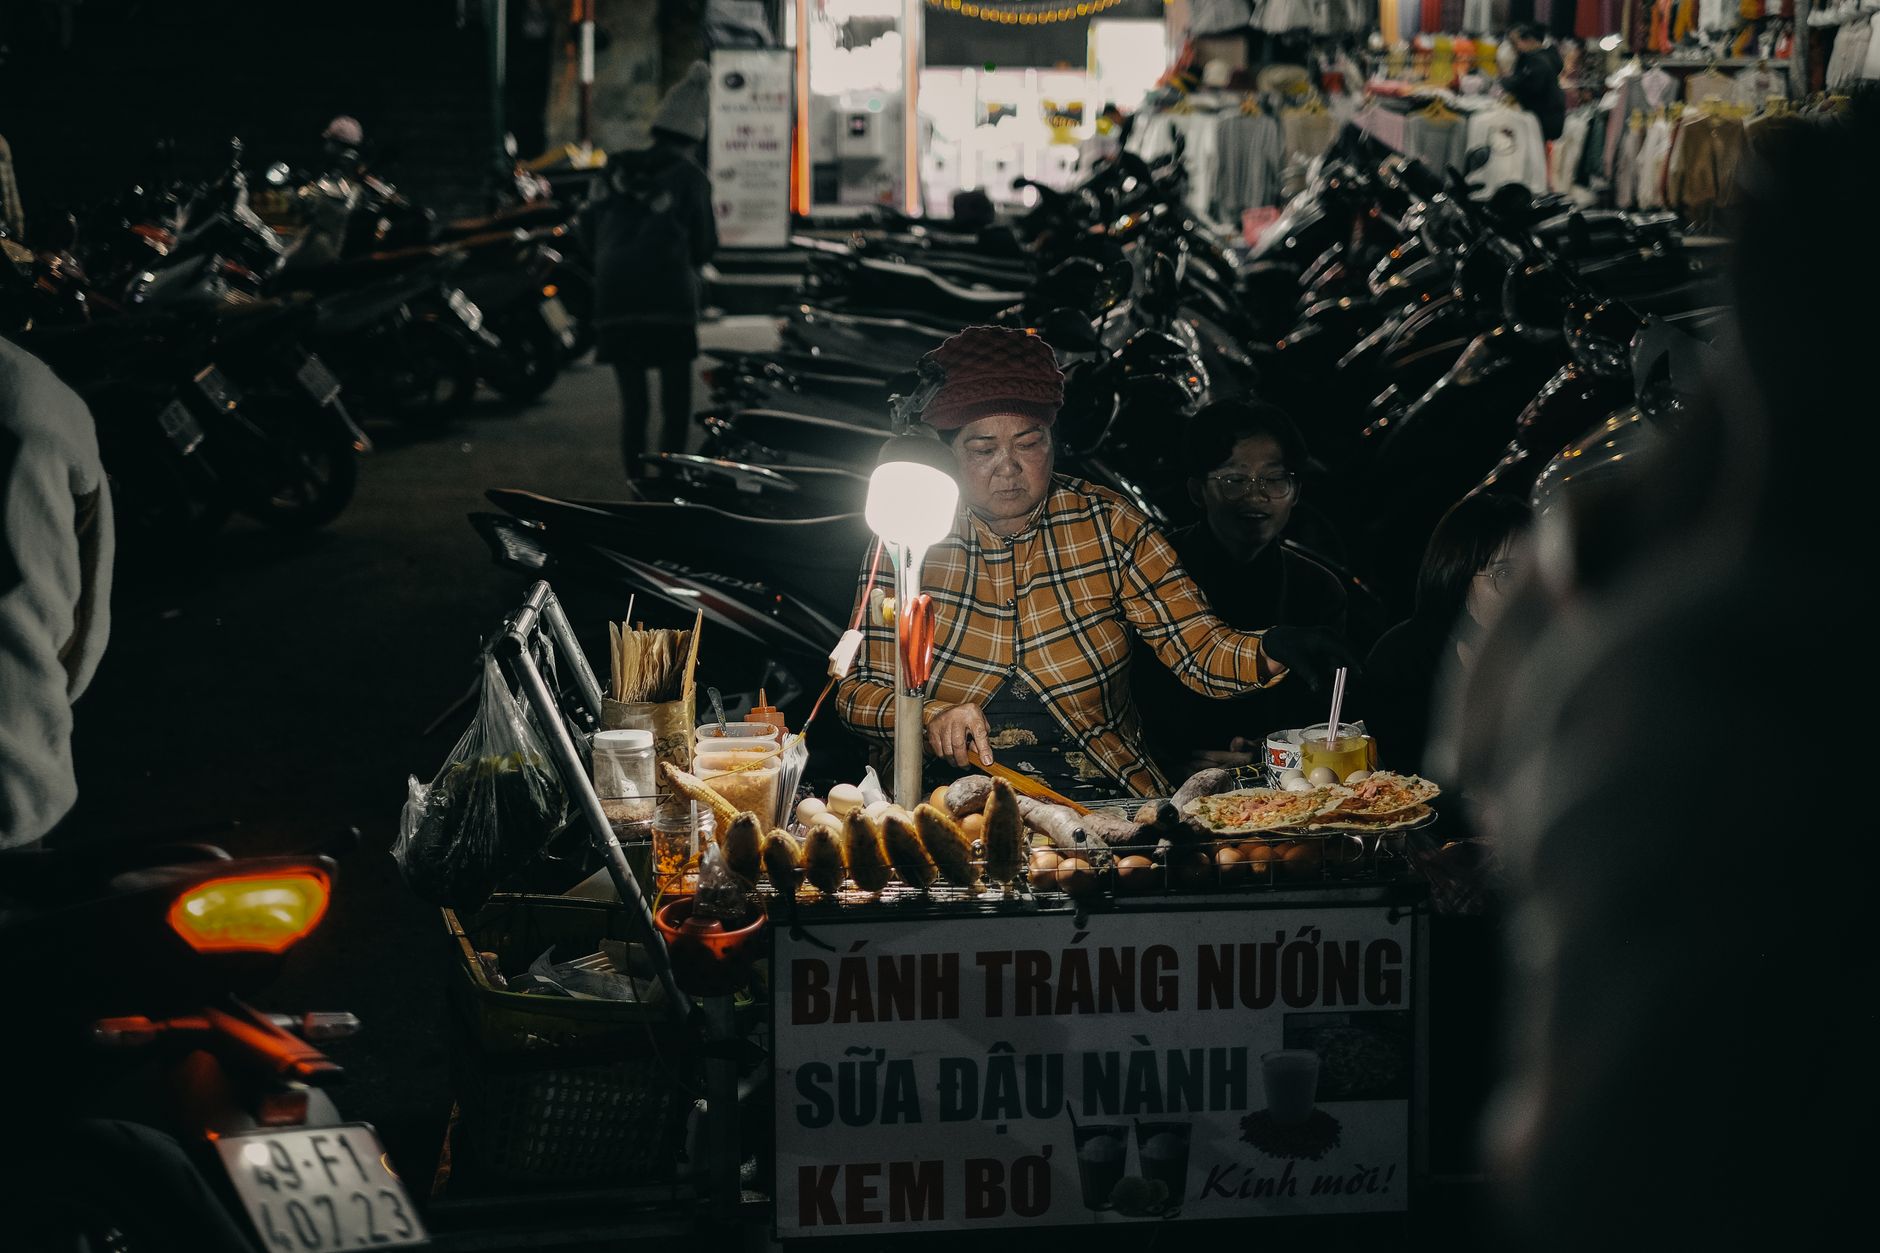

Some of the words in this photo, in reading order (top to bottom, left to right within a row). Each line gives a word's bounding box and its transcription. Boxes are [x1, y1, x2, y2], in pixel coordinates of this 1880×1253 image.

[791, 940, 960, 1026] BÁNH
[975, 931, 1179, 1018] TRÁNG
[1197, 925, 1403, 1011] NƯỚNG
[795, 1045, 923, 1129] SỮA
[936, 1041, 1065, 1135] ĐẬU
[1082, 1034, 1249, 1116] NÀNH
[797, 1159, 945, 1227] KEM
[964, 1144, 1053, 1220] BƠ
[1199, 1159, 1298, 1201] Kính
[1309, 1162, 1398, 1198] mời!
